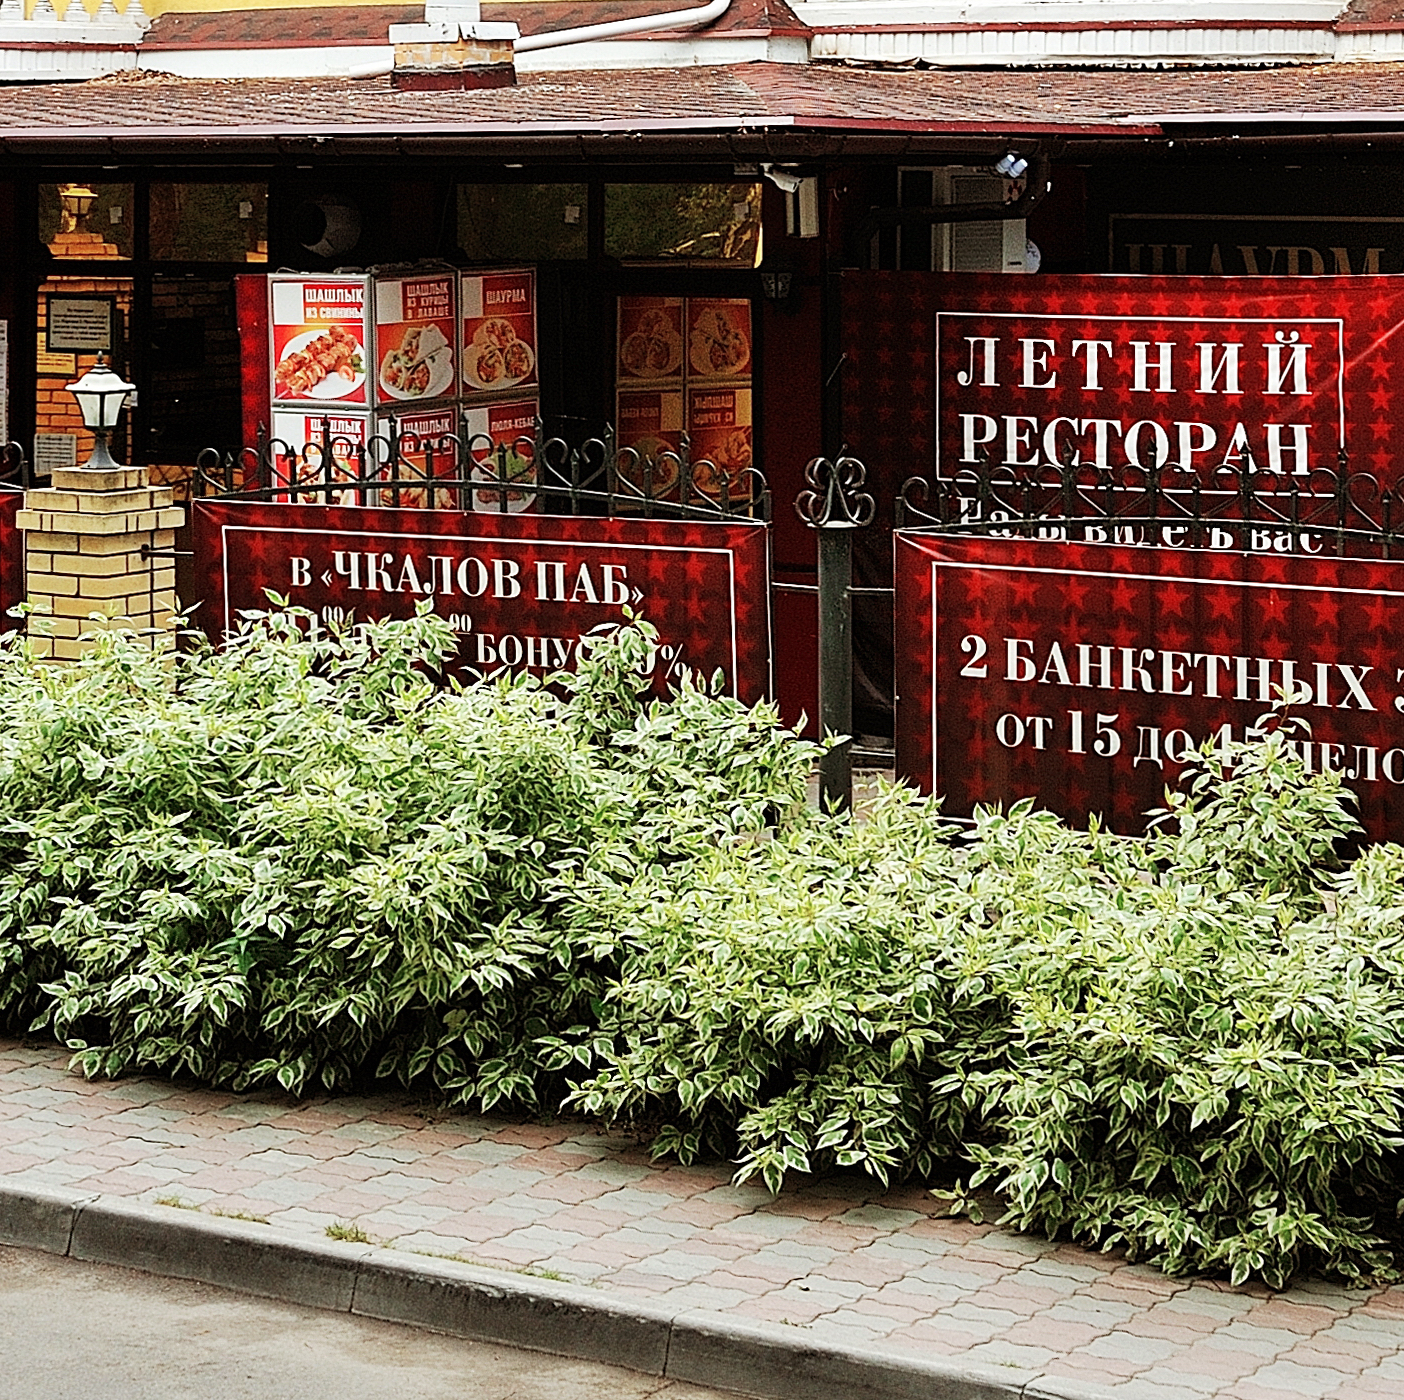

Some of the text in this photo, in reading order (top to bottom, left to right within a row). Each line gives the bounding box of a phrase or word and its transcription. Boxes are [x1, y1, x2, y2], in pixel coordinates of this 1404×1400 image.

[305, 288, 364, 304] ШАШЛЫК
[406, 282, 449, 298] ШАШЛЫК
[485, 288, 527, 305] ШАУРМА
[956, 330, 1313, 396] ЛЕТНИЙ
[957, 412, 1313, 476] РЕСТОРАН
[320, 550, 523, 600] «ЧКАЛОВ
[533, 560, 645, 605] ПАБ»
[959, 634, 989, 680] 2
[1002, 637, 1378, 712] БАНКЕТНЫХ
[1066, 709, 1121, 758] 15
